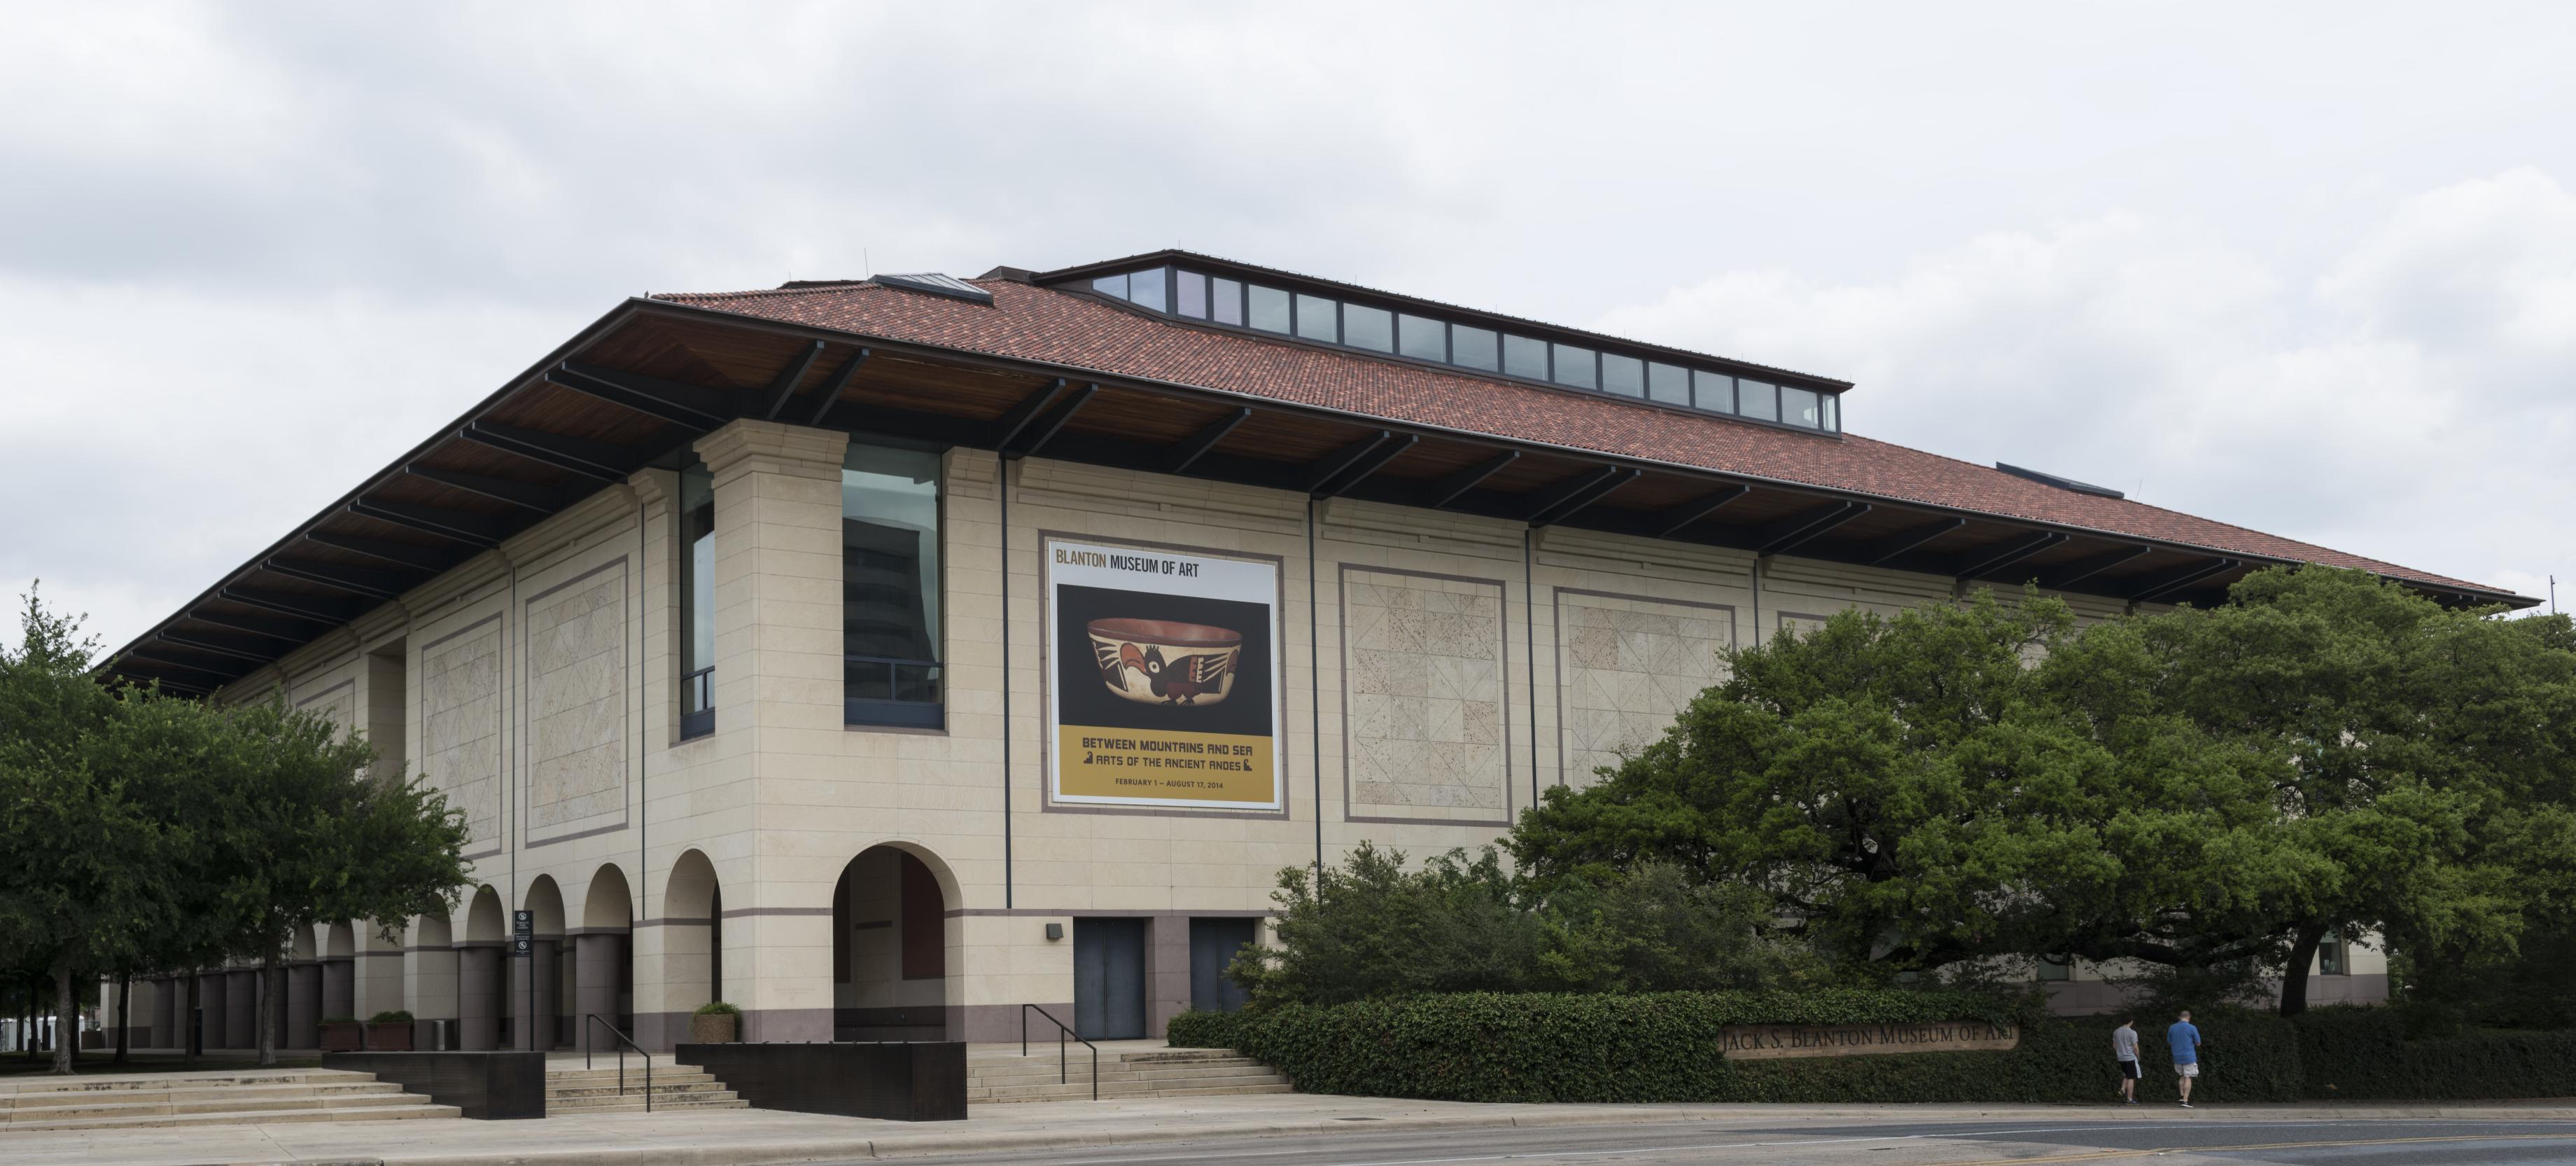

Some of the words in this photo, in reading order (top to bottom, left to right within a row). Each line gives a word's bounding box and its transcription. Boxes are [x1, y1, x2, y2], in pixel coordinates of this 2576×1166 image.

[1056, 548, 1107, 568] BLANTON
[1110, 555, 1158, 574] MUSEUM
[1162, 560, 1176, 575] OF
[1179, 562, 1199, 577] ART
[1082, 737, 1136, 751] BETWEEN
[1140, 740, 1203, 754] MOUNTAINS
[1208, 744, 1229, 756] AND
[1233, 745, 1252, 756] SEA
[1096, 755, 1123, 765] ARTS
[1127, 756, 1139, 766] OF
[1143, 757, 1161, 768] THE
[1165, 758, 1205, 770] ANCIENT
[1209, 761, 1240, 771] ANDES
[1722, 1030, 1765, 1053] JACK
[1771, 1028, 1784, 1048] S.
[1791, 1029, 1872, 1047] BLANTON
[1880, 1026, 1952, 1044] MUSEUM
[1959, 1026, 1980, 1041] OF
